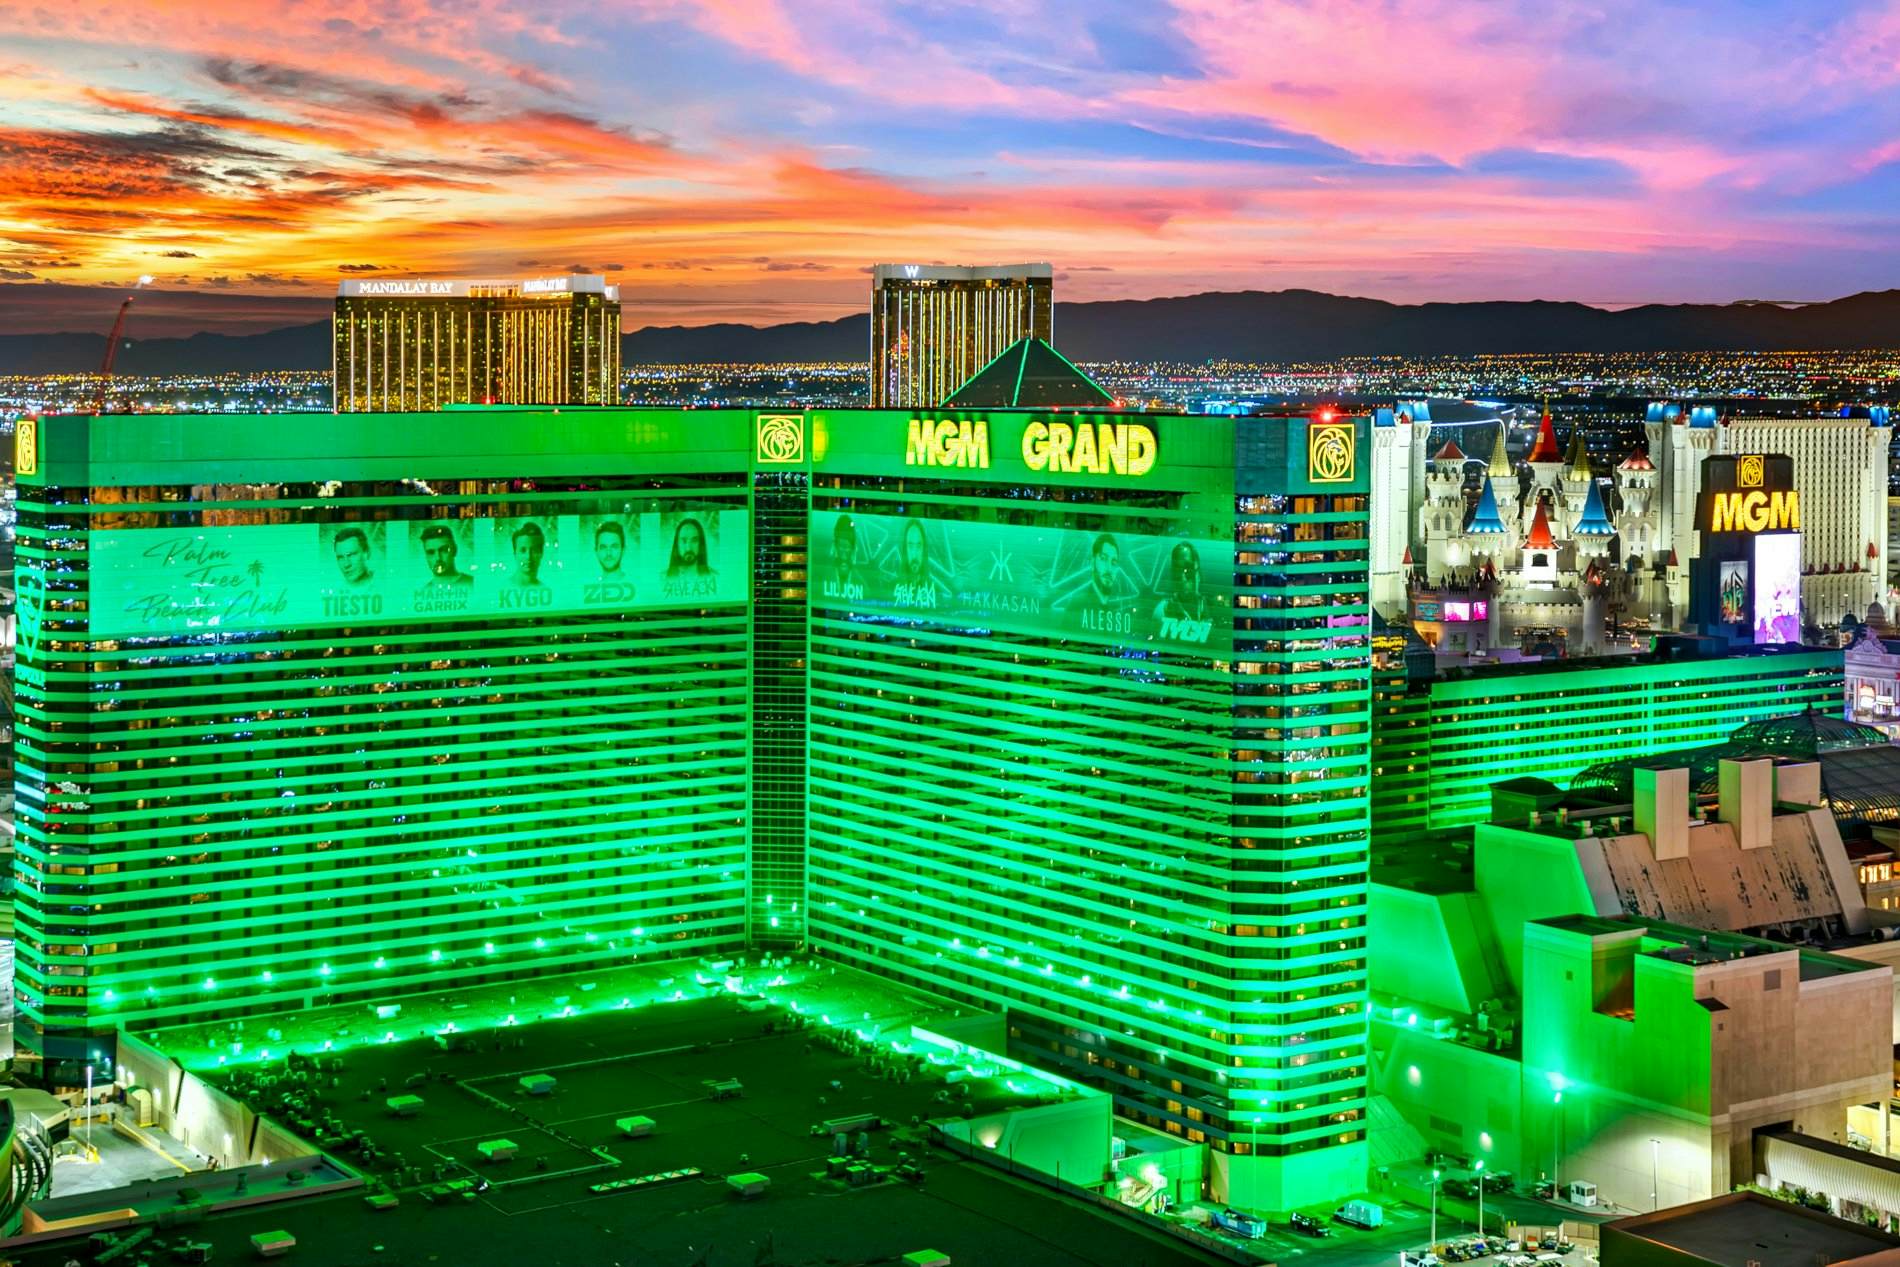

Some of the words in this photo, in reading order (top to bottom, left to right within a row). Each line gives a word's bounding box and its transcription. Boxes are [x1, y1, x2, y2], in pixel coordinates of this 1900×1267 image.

[904, 265, 920, 278] W
[359, 282, 428, 294] MANDALAY
[430, 282, 453, 294] BAY
[905, 419, 989, 469] MGM
[1021, 421, 1158, 476] GRAND
[1711, 490, 1801, 532] MGM
[143, 537, 231, 567] Palm
[184, 563, 246, 594] Tree
[824, 580, 840, 597] LIL
[841, 583, 863, 600] JON
[223, 588, 288, 622] Club
[414, 599, 468, 613] GARRIX
[499, 587, 552, 609] KYGO
[962, 592, 1040, 614] HAKKASAN
[1081, 608, 1131, 634] ALESSO
